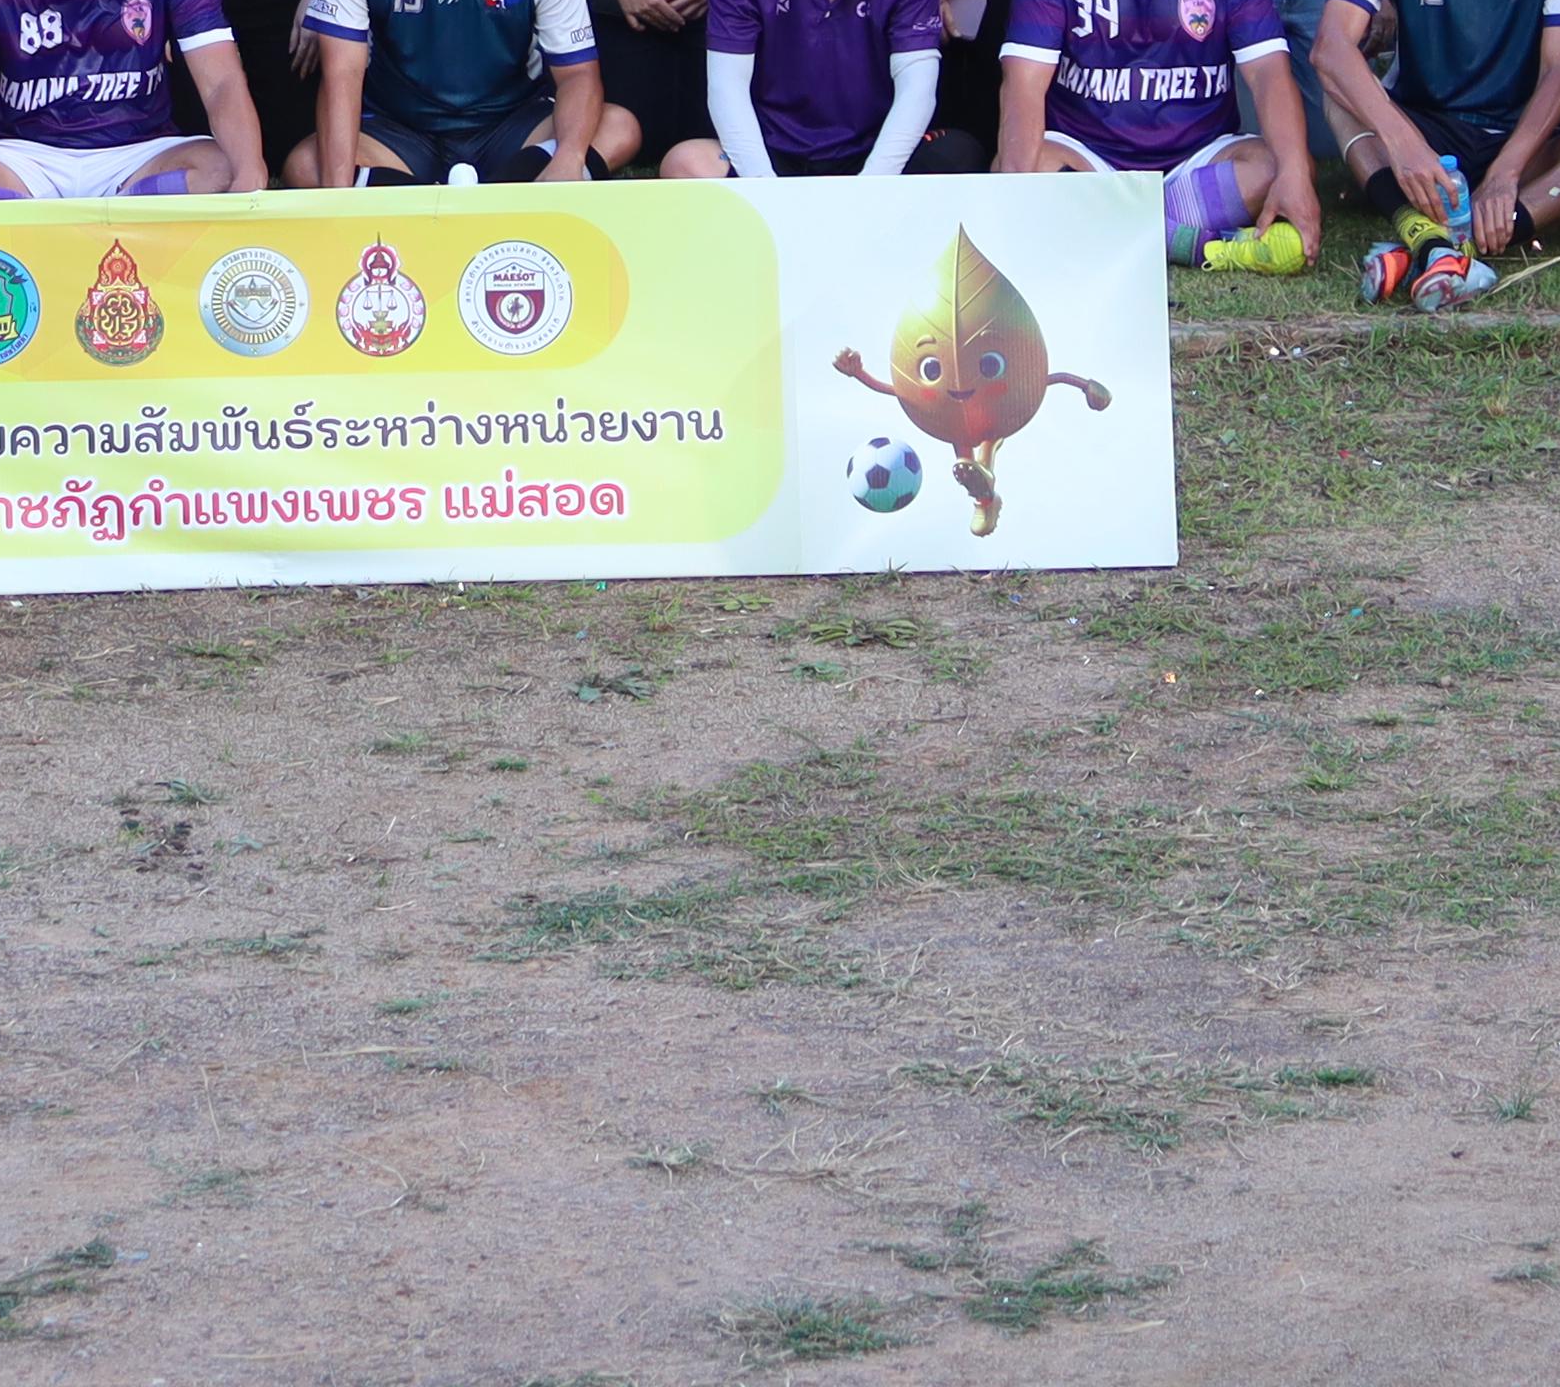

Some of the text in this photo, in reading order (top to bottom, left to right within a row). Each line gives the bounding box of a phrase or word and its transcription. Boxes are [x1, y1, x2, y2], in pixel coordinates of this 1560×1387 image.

[19, 8, 63, 55] 88
[83, 72, 141, 103] TREE
[1140, 66, 1197, 102] TREE
[492, 271, 537, 283] MAESOT
[443, 469, 625, 520] แม่สอด
